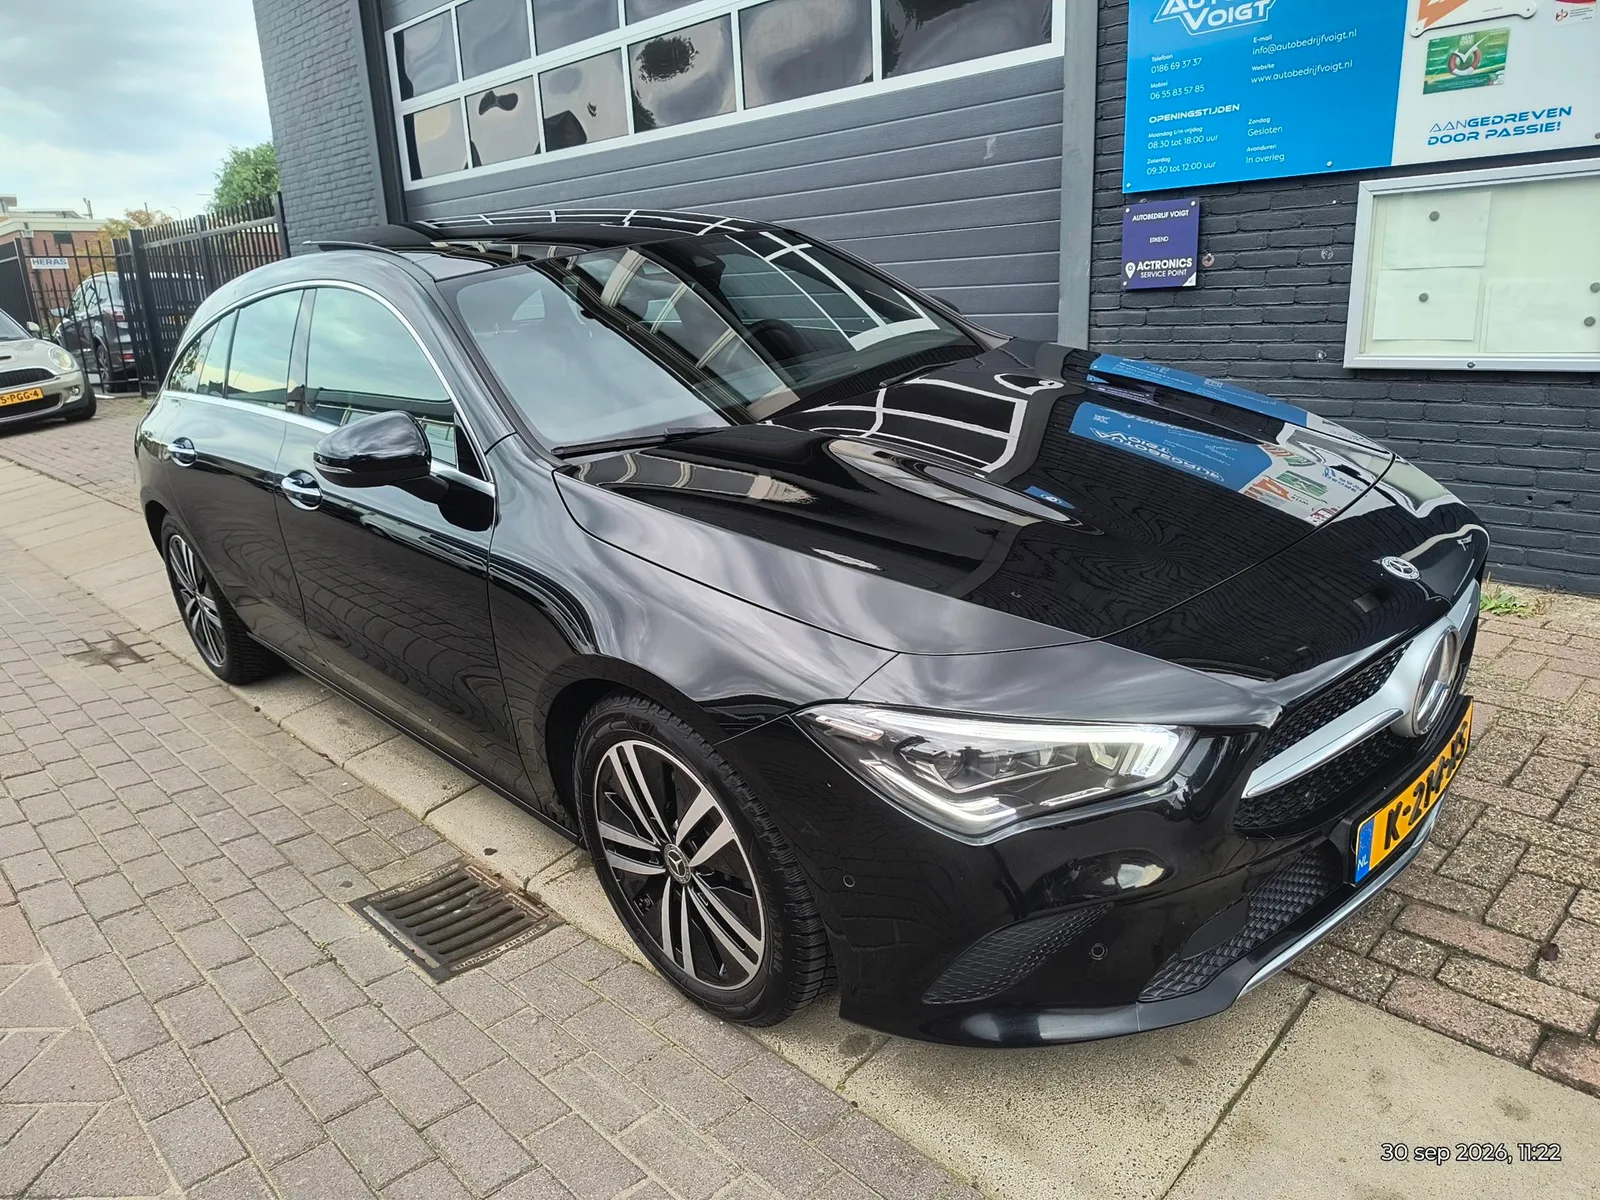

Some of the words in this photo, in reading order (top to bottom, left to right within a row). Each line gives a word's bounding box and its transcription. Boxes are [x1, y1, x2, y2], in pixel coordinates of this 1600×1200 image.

[1183, 0, 1271, 31] VOIGT
[1252, 28, 1357, 55] info@autobedrijfvoigt.nl
[1253, 34, 1273, 44] E-mail
[1151, 54, 1173, 62] Telefoon
[1150, 63, 1169, 74] 0186
[1170, 61, 1180, 70] 69
[1181, 60, 1192, 69] 37
[1192, 58, 1202, 67] 37
[1250, 59, 1353, 84] www.autobedrijfvoigt.nl
[1252, 63, 1275, 72] Website
[1150, 81, 1168, 89] Mobiel
[1150, 91, 1160, 100] 06
[1161, 89, 1172, 98] 55
[1172, 88, 1182, 97] 83
[1183, 86, 1194, 95] 57
[1194, 84, 1205, 93] 85
[1148, 104, 1240, 124] OPENINGSTIJDEN
[1428, 106, 1572, 132] AANGEDREVEN
[1248, 117, 1270, 125] Zondag
[1148, 130, 1172, 138] Maandag
[1184, 126, 1203, 135] vrijdag
[1248, 126, 1283, 136] Gesloten
[1428, 131, 1480, 146] DOOR
[1484, 120, 1562, 140] PASSIE!
[1148, 140, 1170, 150] 08:30
[1171, 138, 1182, 146] tot
[1184, 136, 1204, 144] 18:00
[1246, 144, 1277, 152] Avonduren
[1147, 156, 1171, 164] Zaterdag
[1246, 156, 1254, 164] In
[1254, 153, 1285, 163] overleg
[1146, 166, 1168, 175] 09:30
[1170, 164, 1180, 172] tot
[1182, 162, 1203, 171] 12:00
[1204, 160, 1217, 169] uur
[1132, 211, 1170, 222] AUTOBEDRIJF
[1170, 209, 1190, 218] VOIGT
[1136, 258, 1193, 271] ACTRONICS
[1140, 270, 1166, 278] SERVICE
[1168, 268, 1188, 277] POINT
[1356, 855, 1369, 872] NL
